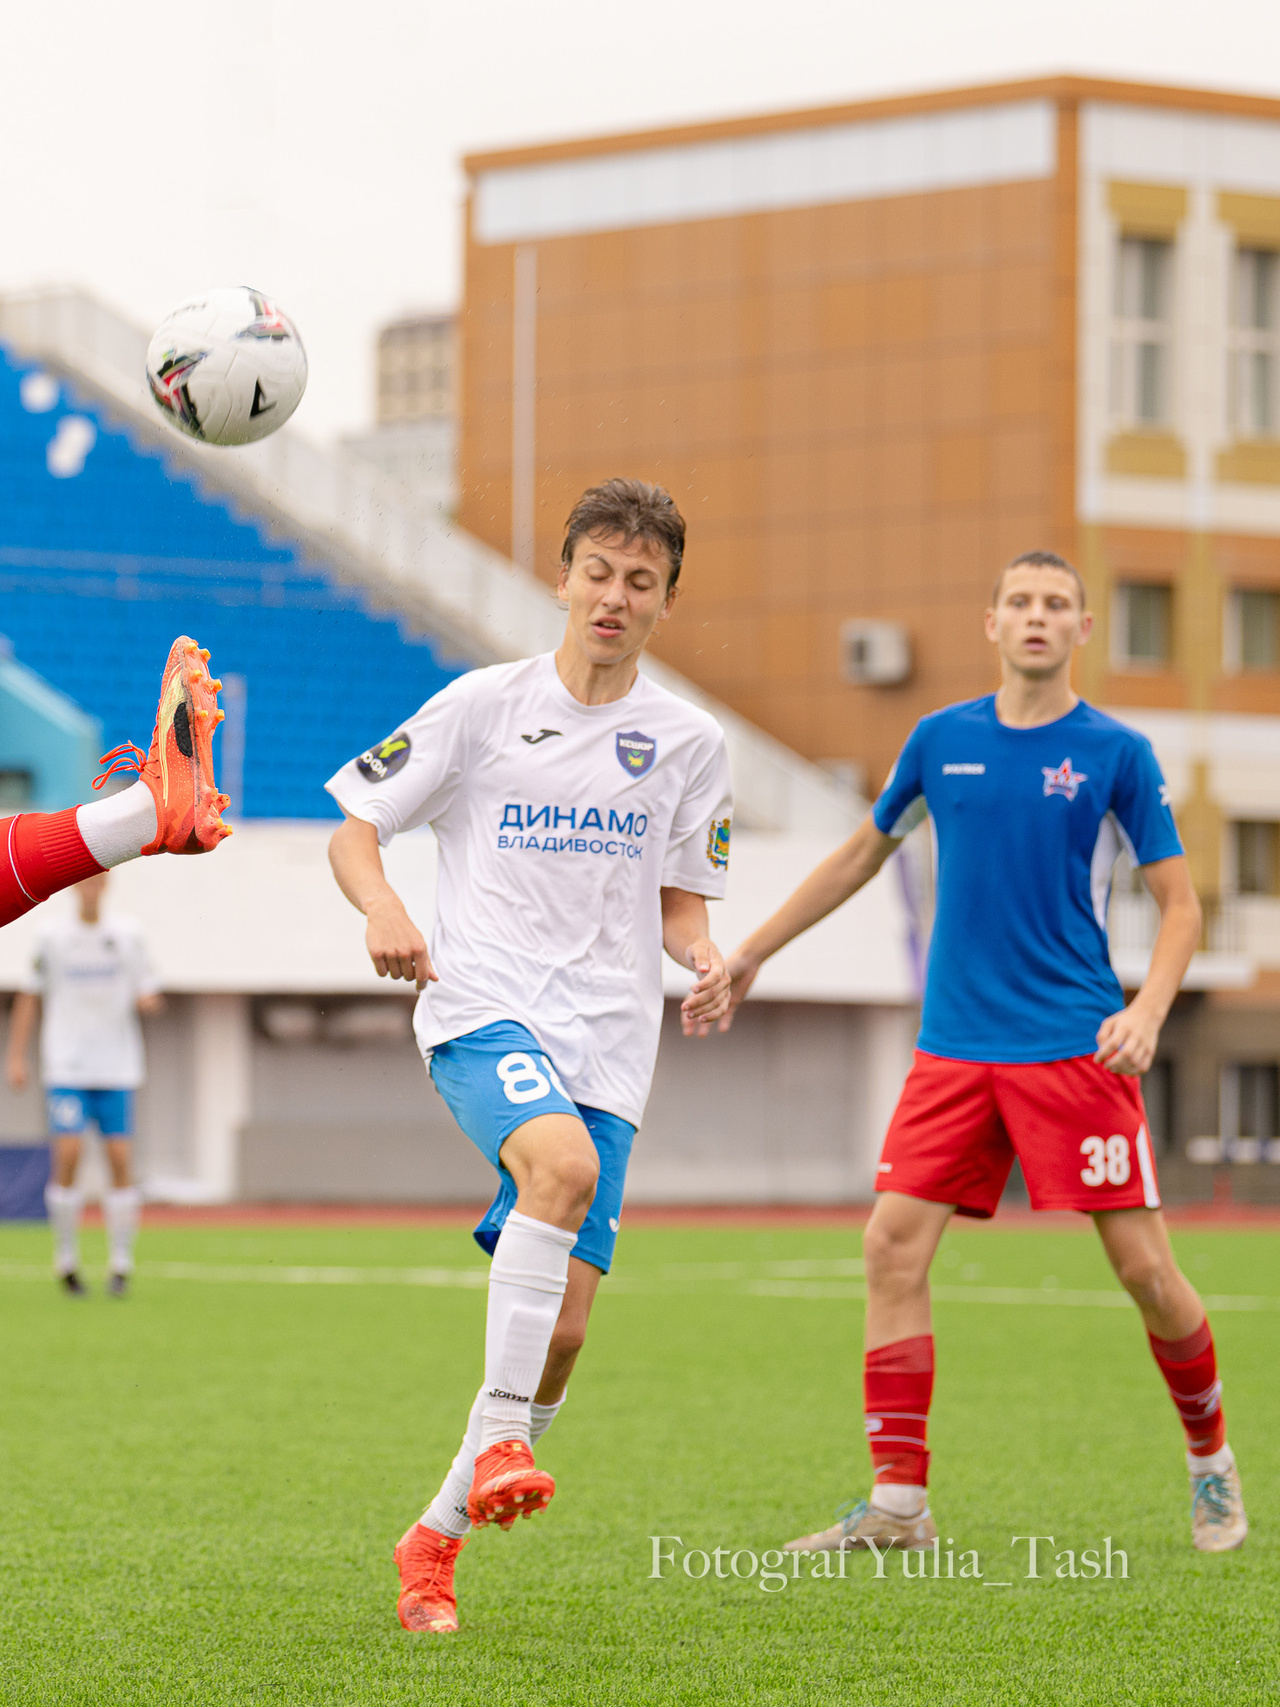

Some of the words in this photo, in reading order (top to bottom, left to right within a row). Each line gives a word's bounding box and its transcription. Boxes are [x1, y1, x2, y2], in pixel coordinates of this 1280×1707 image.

[499, 804, 648, 837] ДИНАМО
[497, 835, 643, 860] ВЛАДИВОСТОК
[1080, 1135, 1131, 1187] 38
